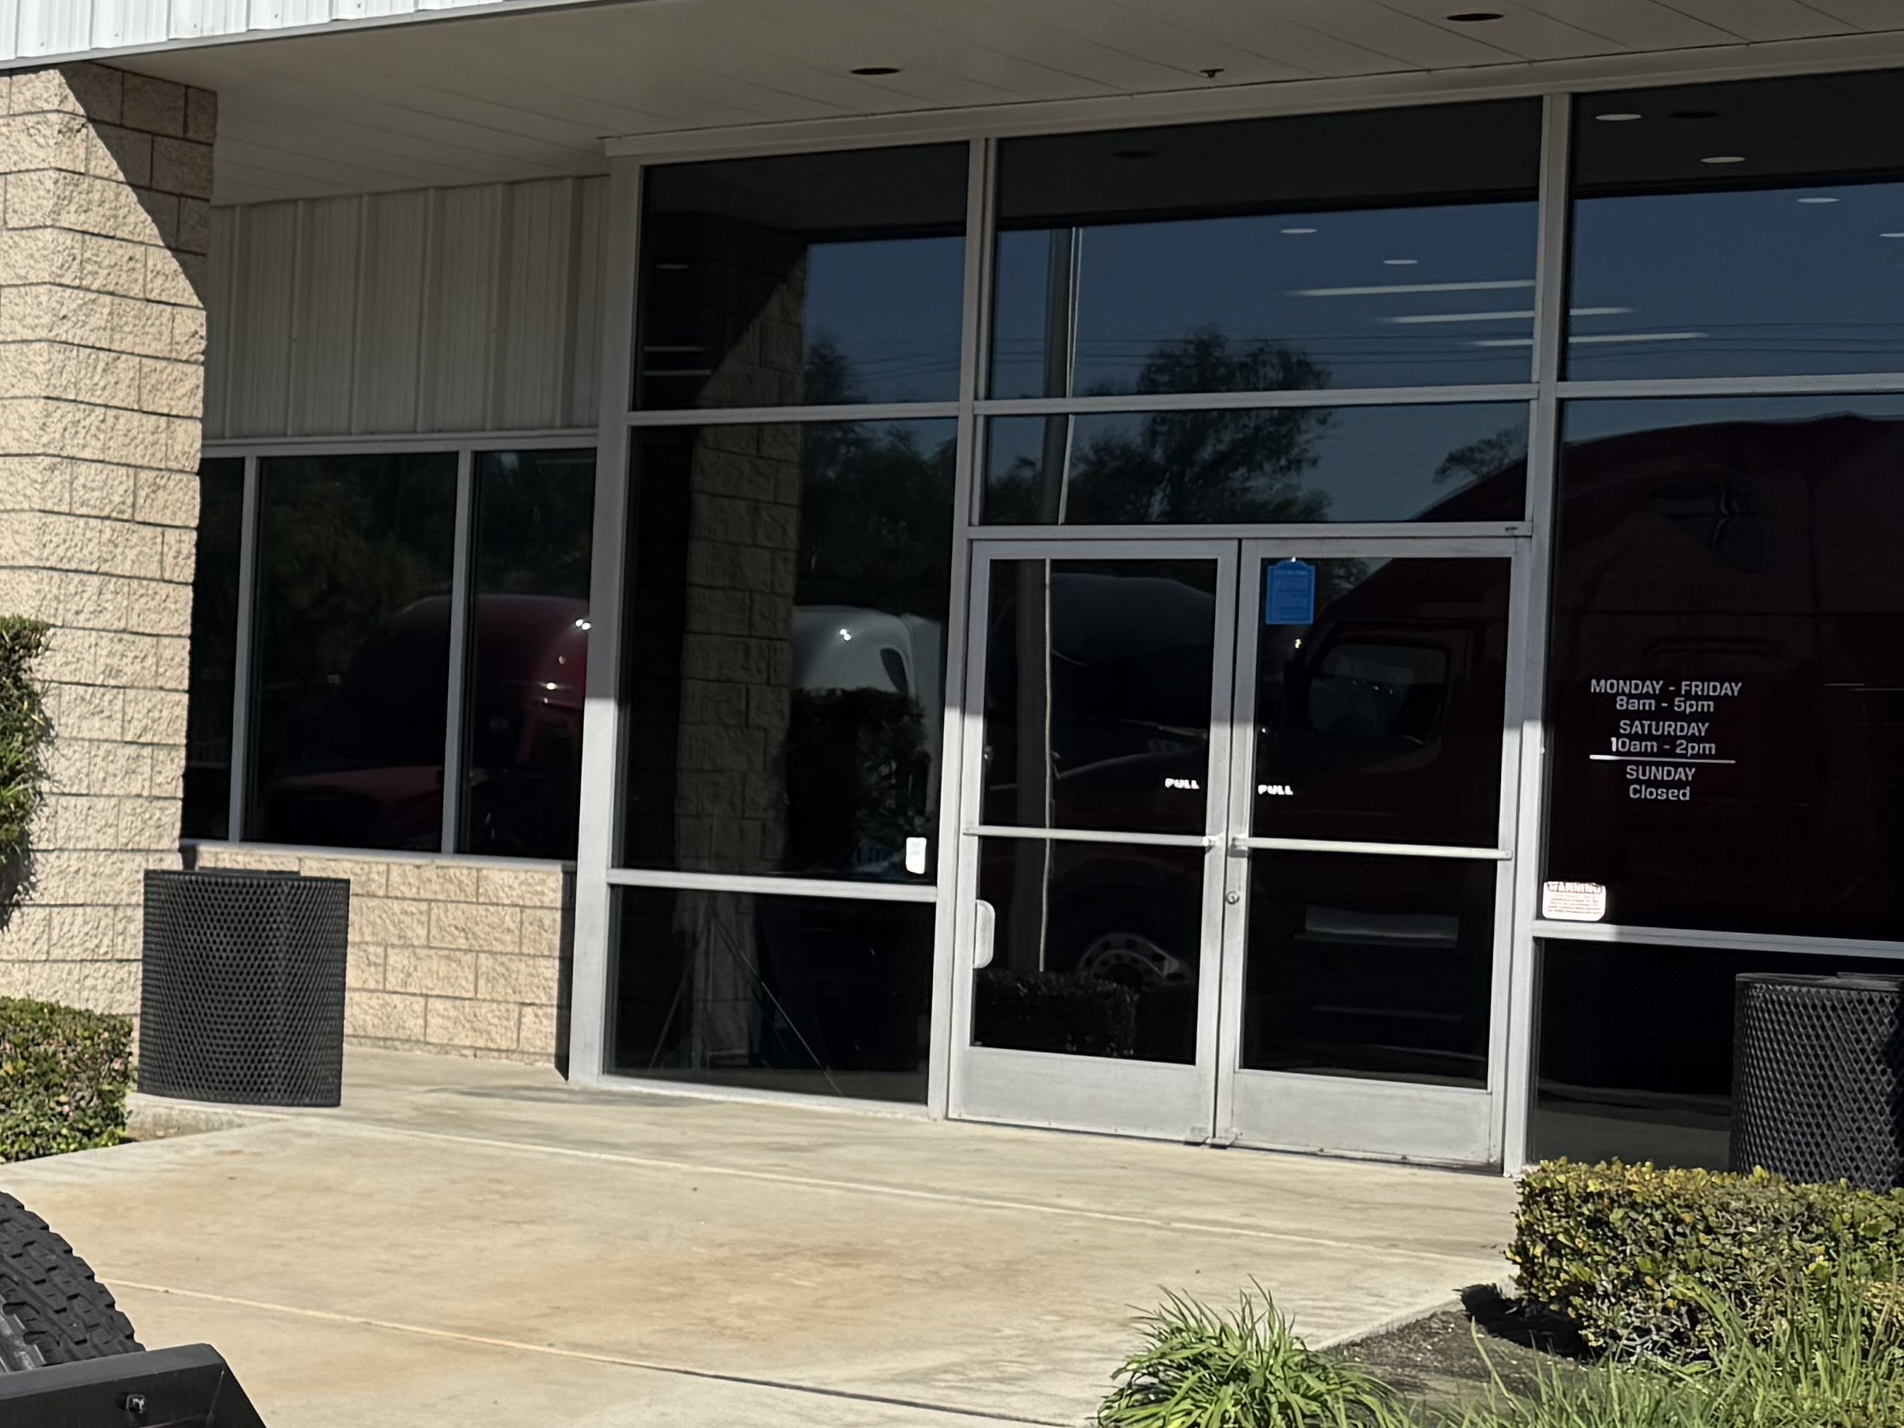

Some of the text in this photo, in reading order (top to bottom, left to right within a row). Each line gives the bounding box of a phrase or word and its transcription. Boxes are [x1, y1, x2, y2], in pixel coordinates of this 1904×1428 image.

[1591, 679, 1663, 696] MONDAY
[1681, 681, 1742, 697] FRIDAY
[1616, 696, 1656, 711] 8am
[1673, 698, 1714, 713] 5pm
[1619, 720, 1709, 737] SATURDAY
[1611, 737, 1657, 753] 10am
[1675, 740, 1716, 756] 2pm
[1626, 765, 1695, 782] SUNDAY
[1164, 778, 1200, 790] PULL
[1257, 784, 1294, 795] PULL
[1629, 784, 1690, 801] Closed
